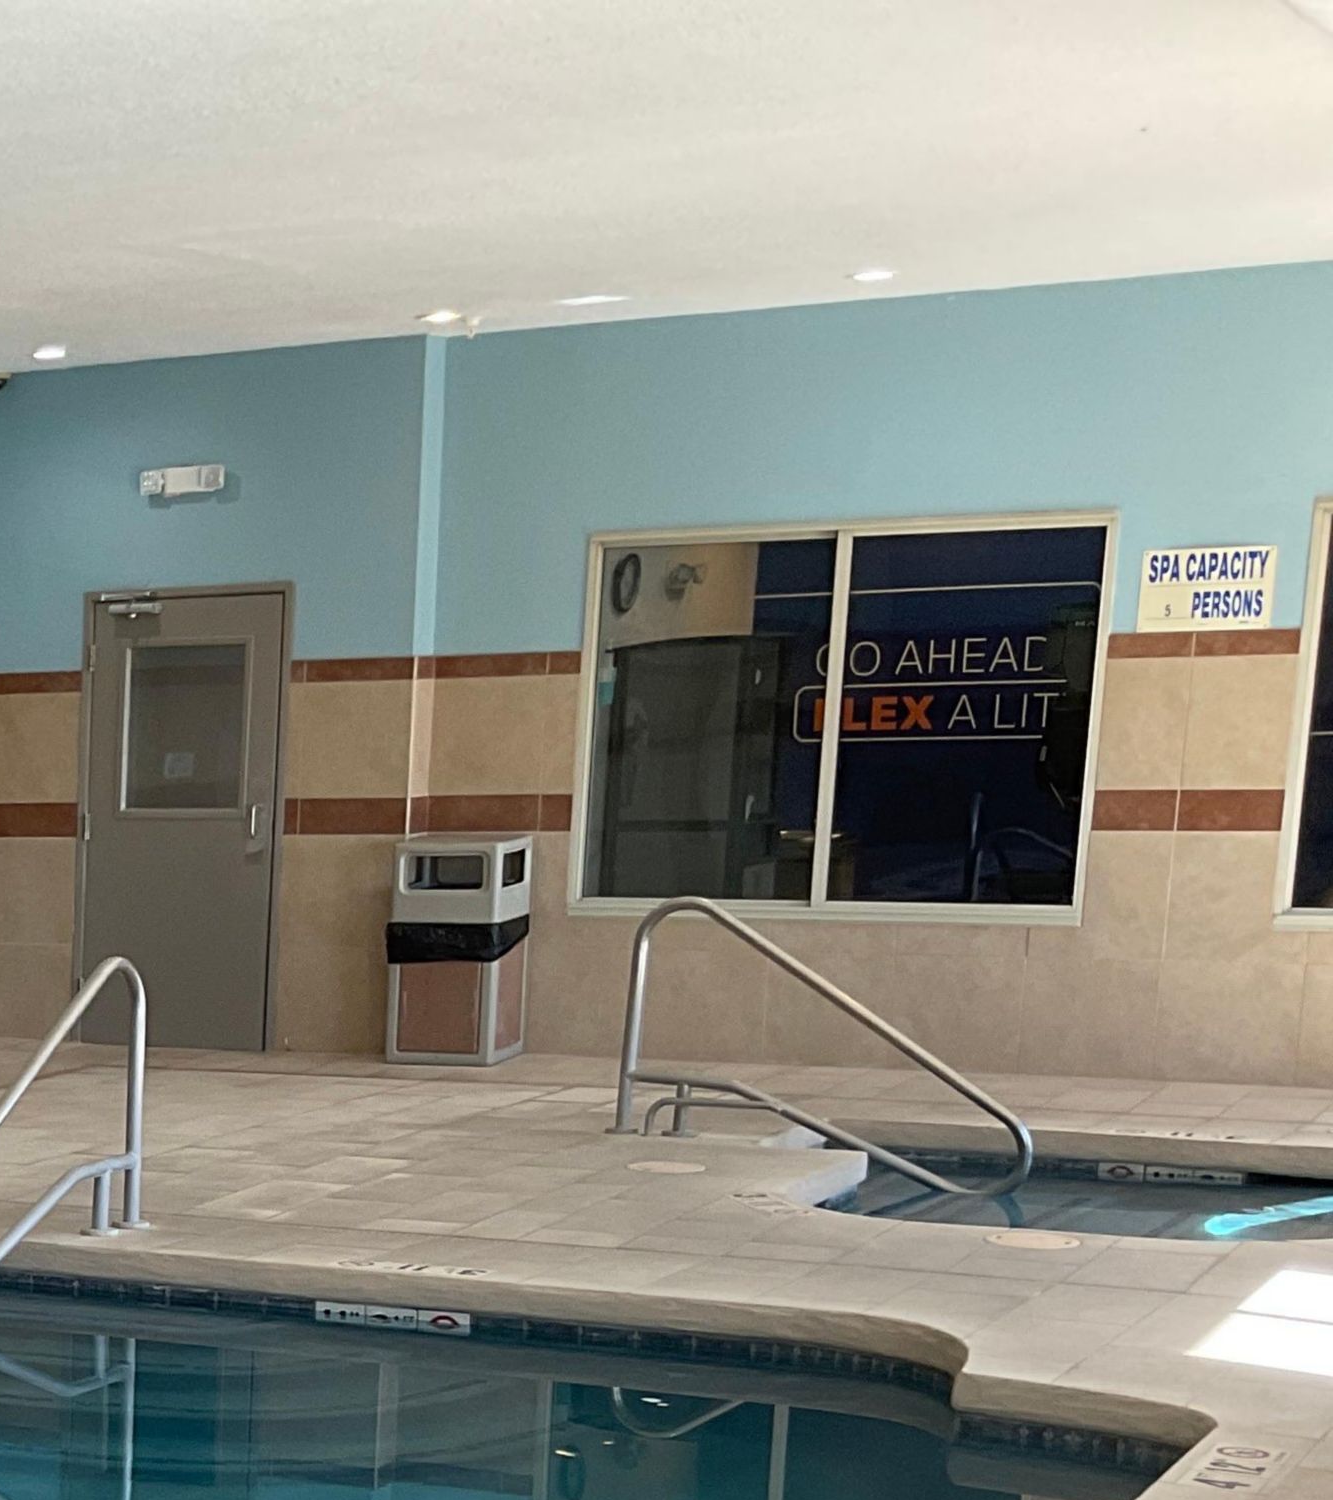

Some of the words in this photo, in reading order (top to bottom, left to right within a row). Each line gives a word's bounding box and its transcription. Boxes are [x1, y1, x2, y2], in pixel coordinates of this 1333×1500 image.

[1149, 553, 1180, 583] SPA
[1186, 550, 1270, 581] CAPACITY
[1164, 604, 1171, 617] 5
[1191, 589, 1264, 618] PERSONS
[947, 694, 977, 729] A
